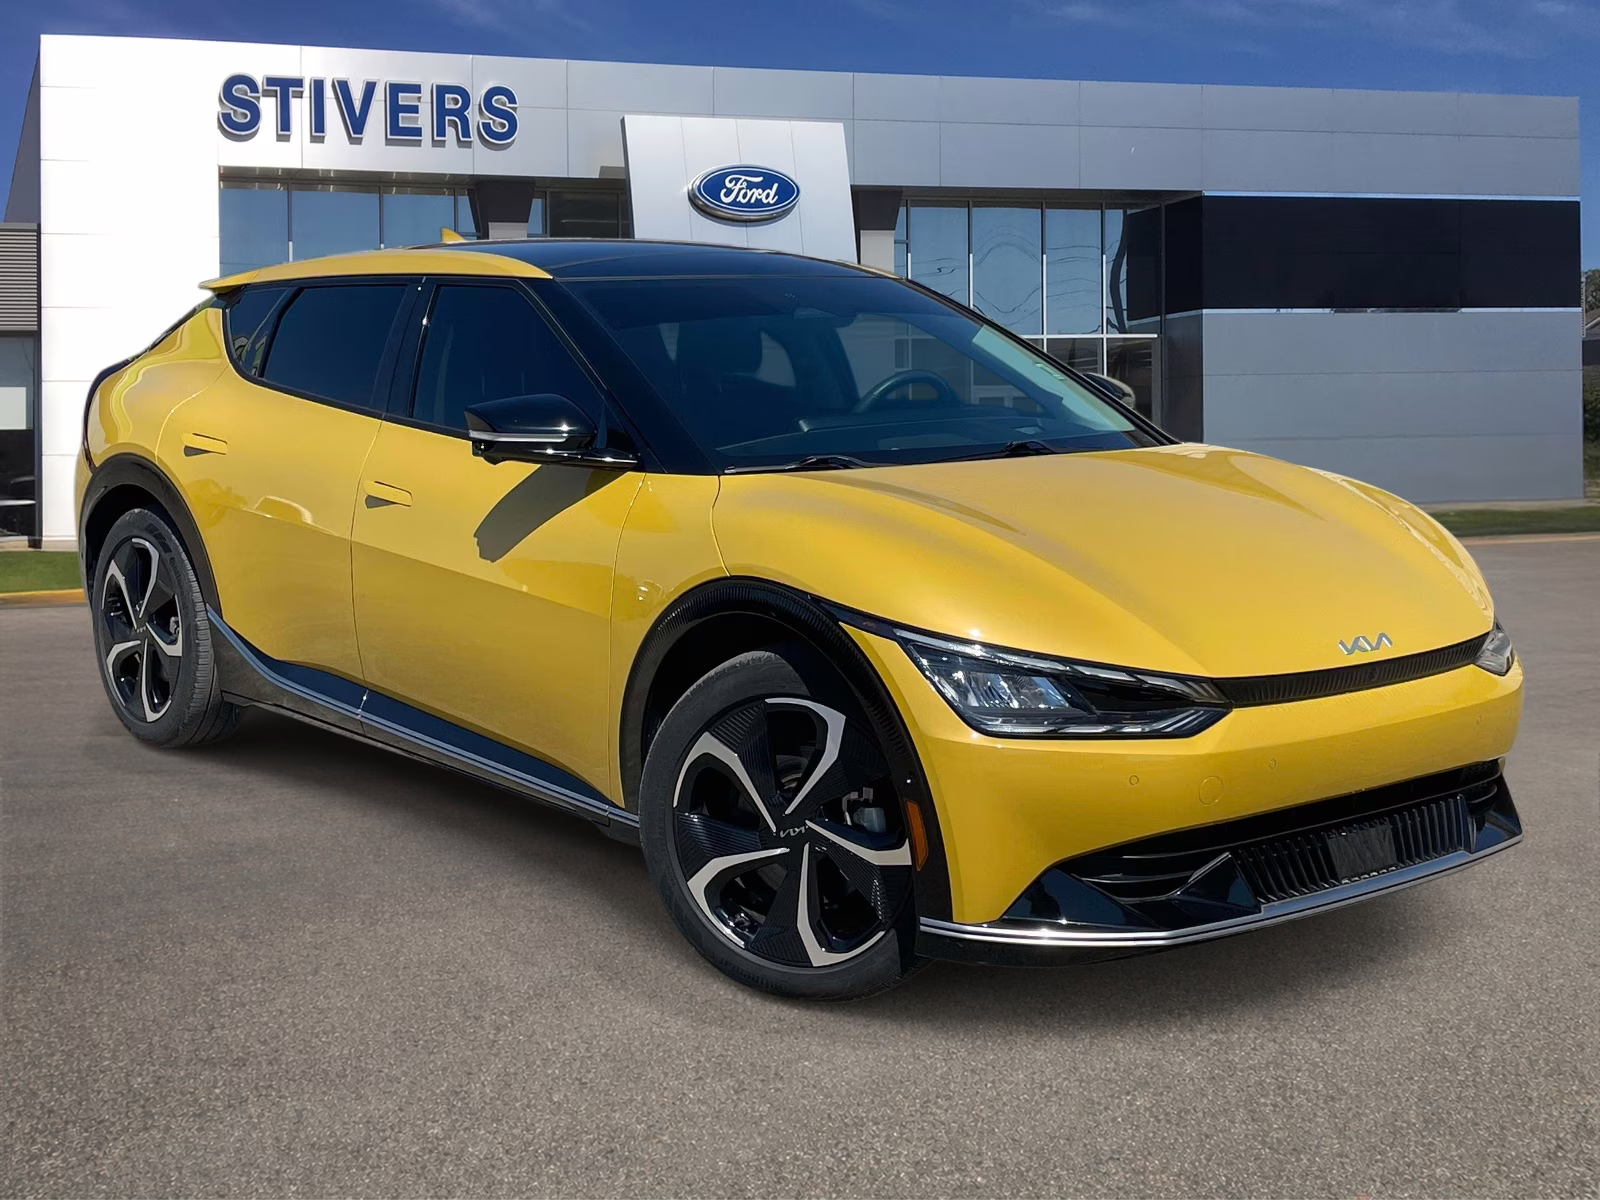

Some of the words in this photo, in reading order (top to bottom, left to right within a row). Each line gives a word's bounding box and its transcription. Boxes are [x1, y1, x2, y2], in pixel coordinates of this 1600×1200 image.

[218, 73, 519, 146] STIVERS
[720, 174, 779, 204] Ford
[1338, 632, 1393, 655] KIA
